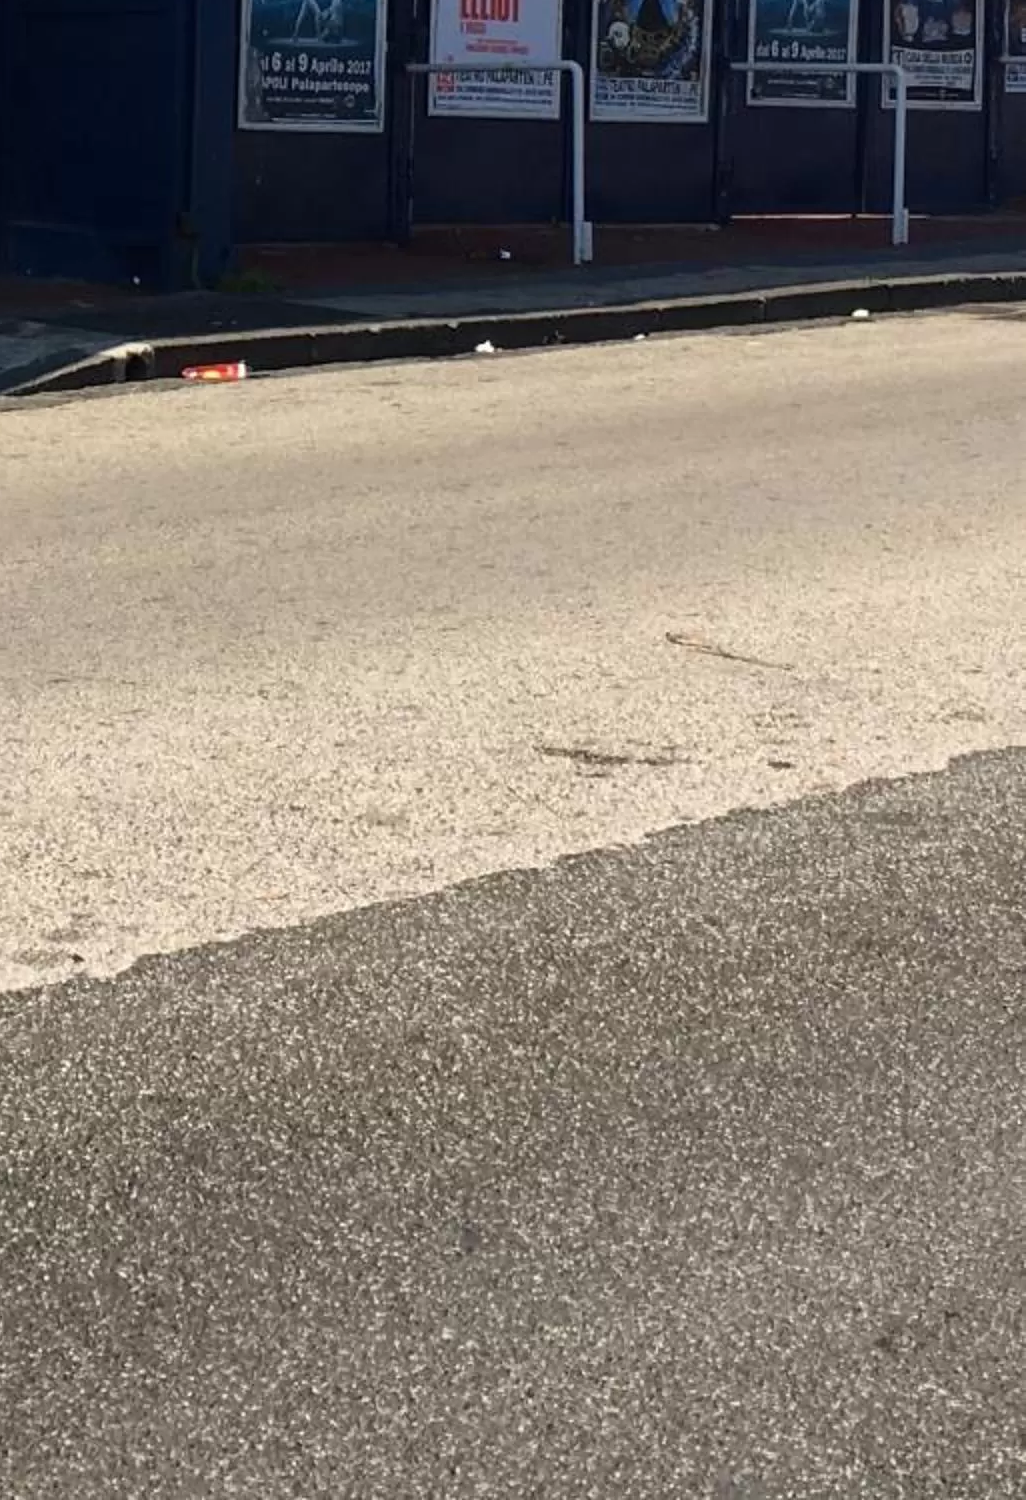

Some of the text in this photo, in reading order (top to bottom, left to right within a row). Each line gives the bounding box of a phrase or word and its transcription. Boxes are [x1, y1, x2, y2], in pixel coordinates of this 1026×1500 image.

[791, 40, 800, 59] 9
[271, 52, 282, 73] 6
[298, 53, 309, 73] 9
[310, 57, 345, 77] Aprile
[346, 59, 371, 75] 2017
